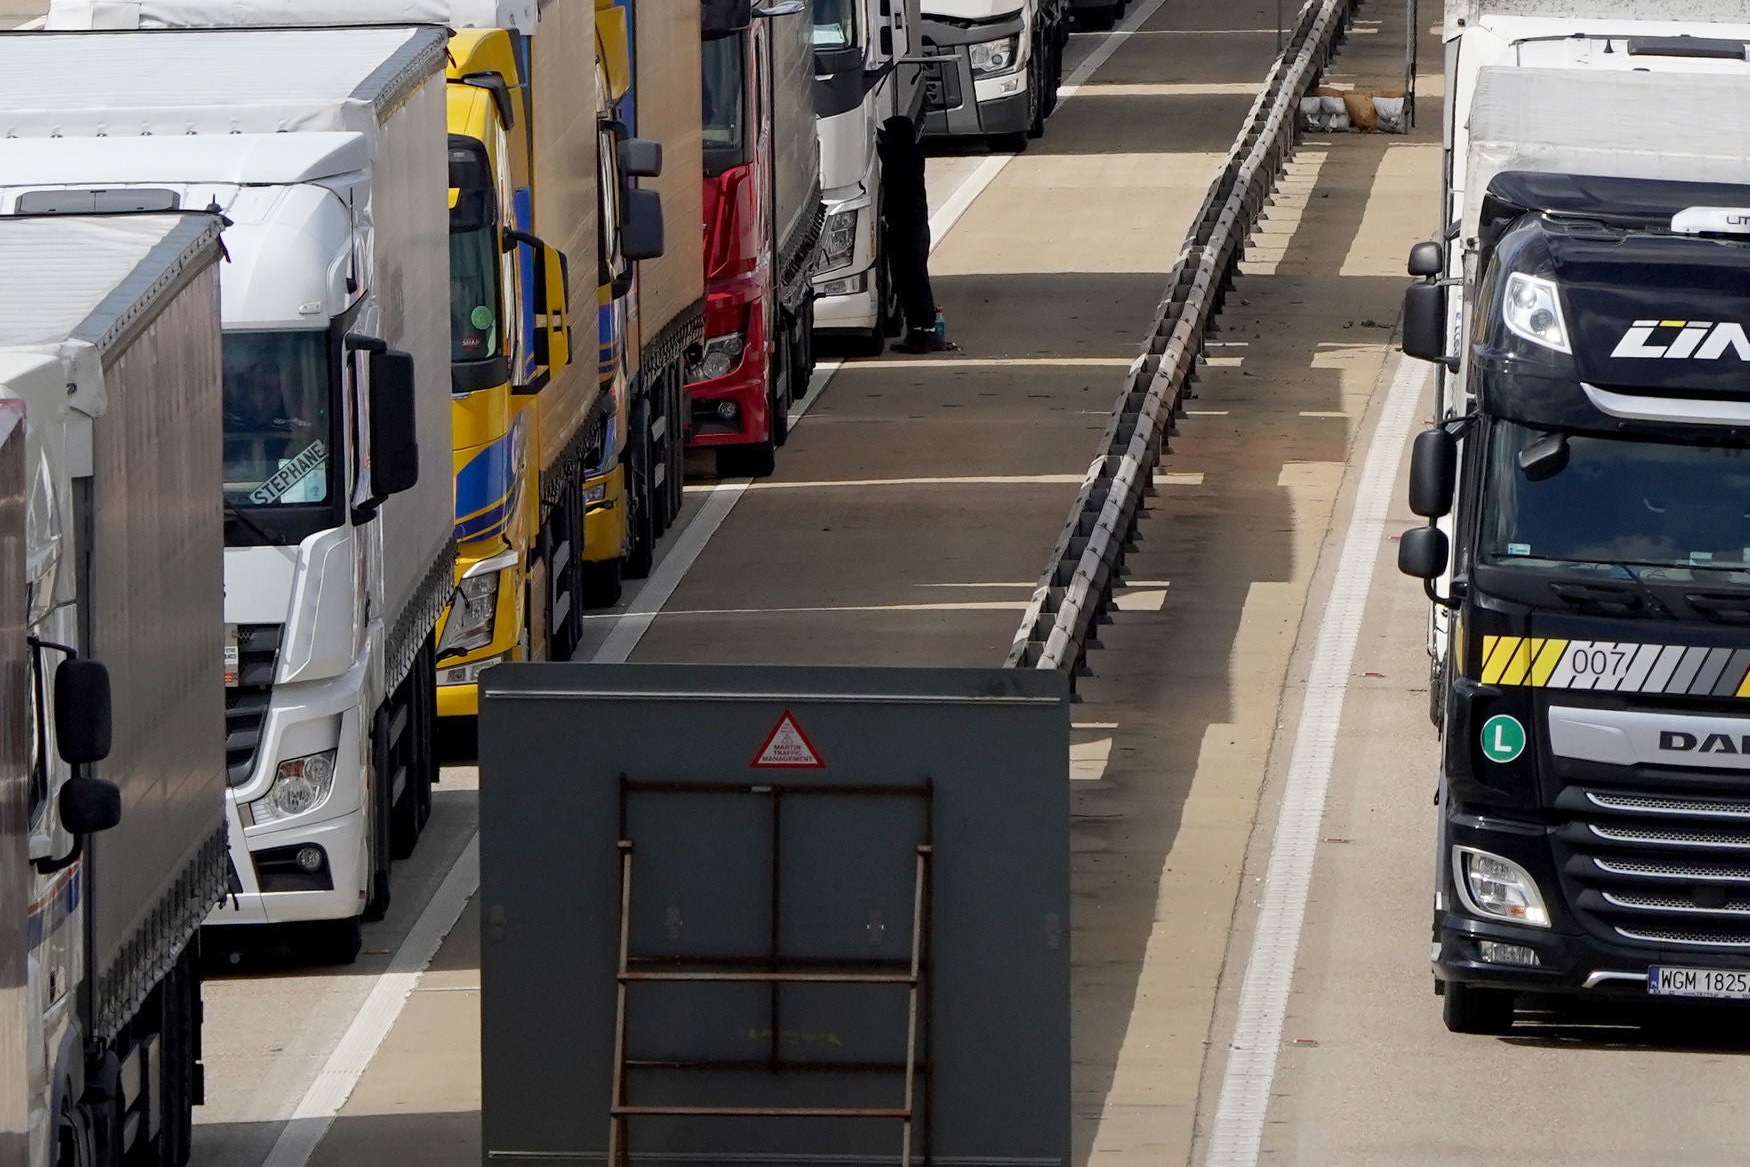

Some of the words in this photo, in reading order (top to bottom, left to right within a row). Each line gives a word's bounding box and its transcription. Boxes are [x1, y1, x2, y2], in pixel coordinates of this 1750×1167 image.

[253, 443, 327, 504] STEPHANE
[1572, 649, 1626, 676] 007
[1494, 724, 1512, 752] L
[1661, 970, 1697, 990] WGM
